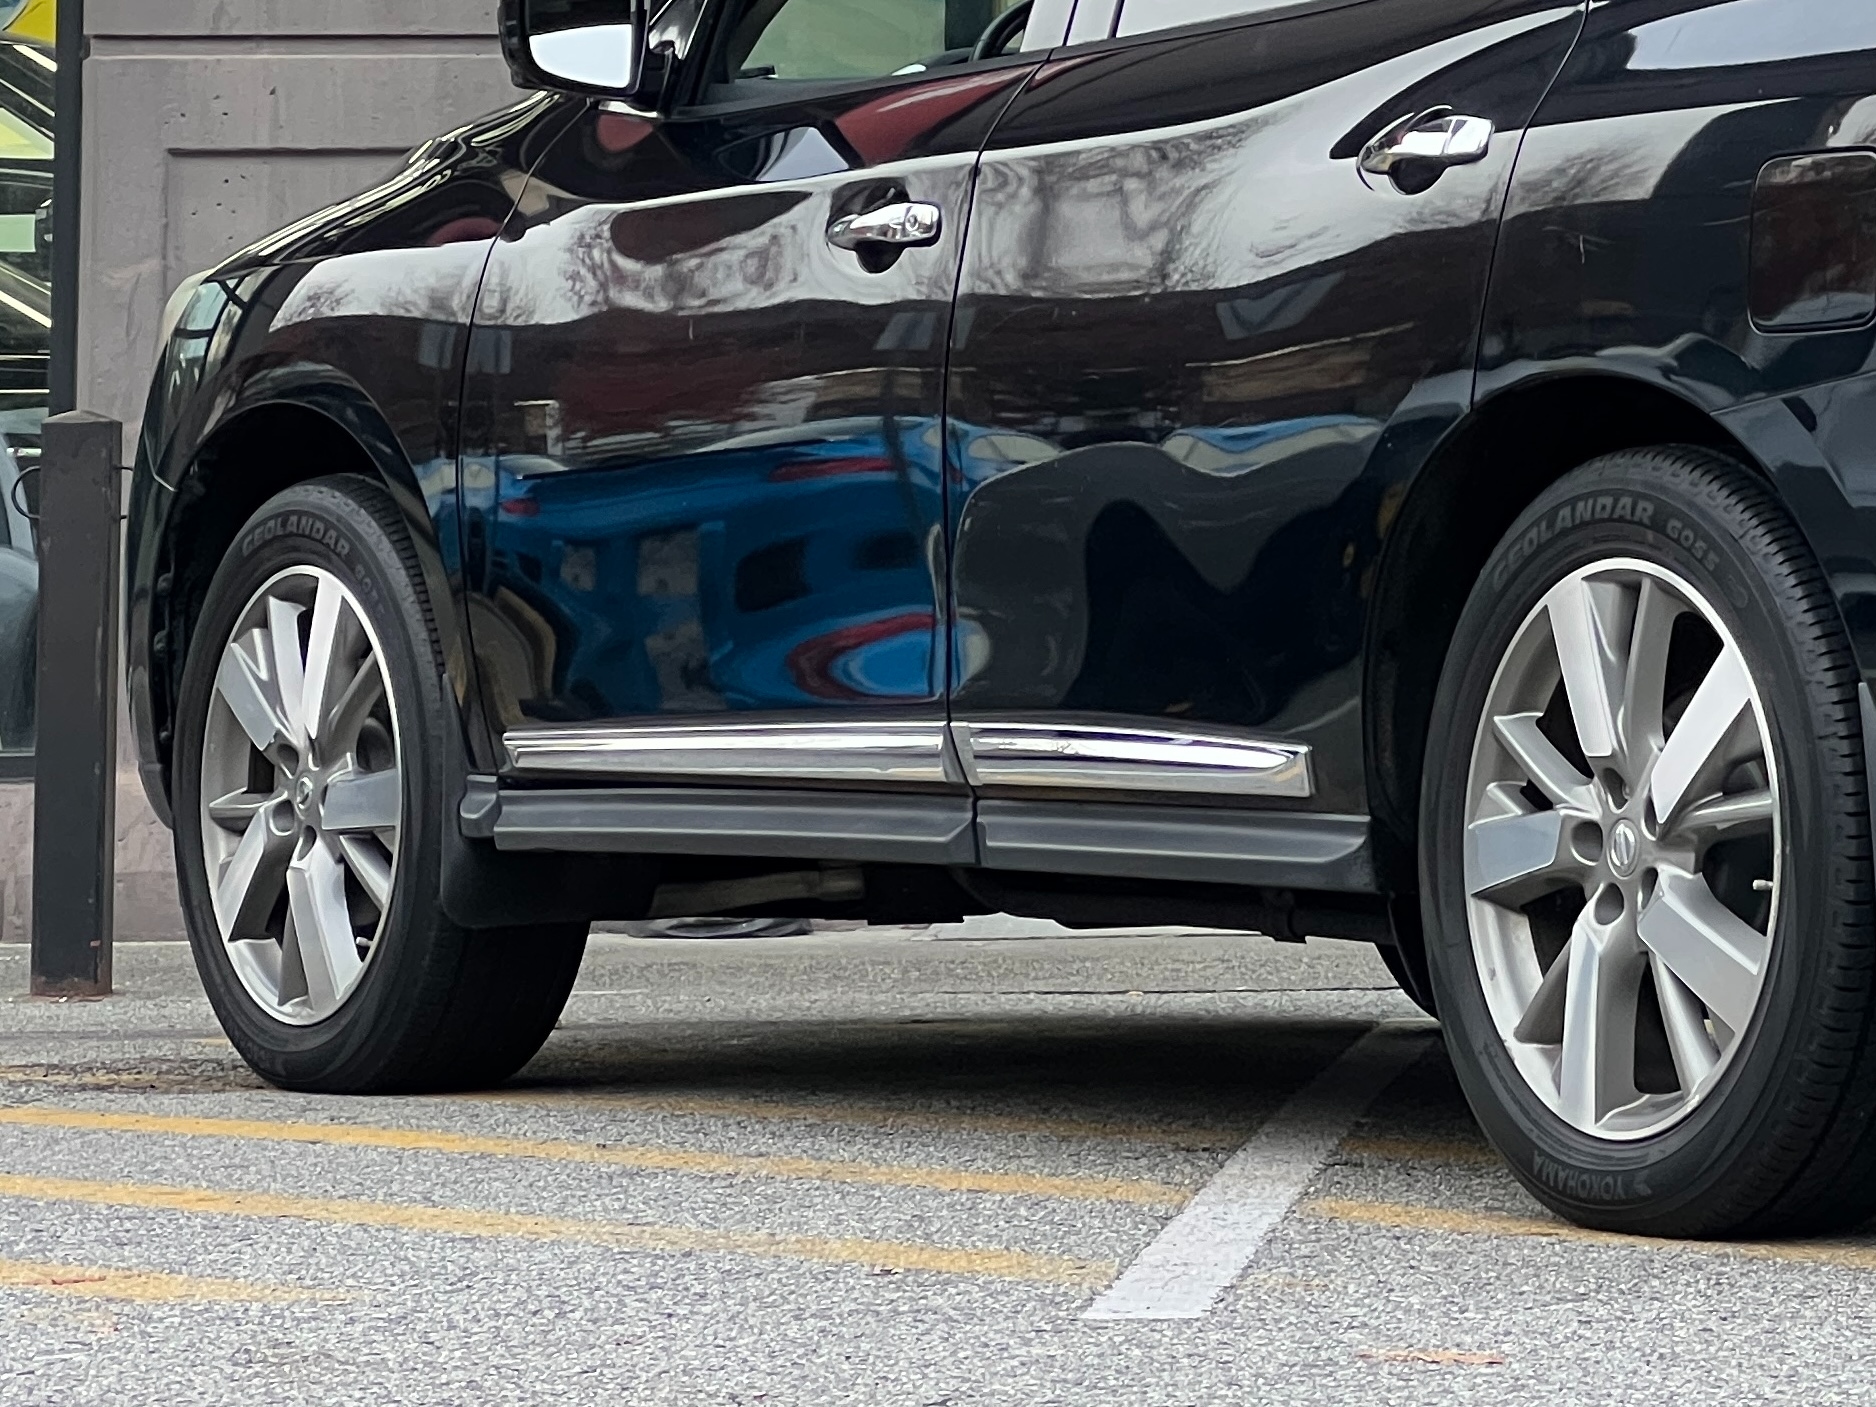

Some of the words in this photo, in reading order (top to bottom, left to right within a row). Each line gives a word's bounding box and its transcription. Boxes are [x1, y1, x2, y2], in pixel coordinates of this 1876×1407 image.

[241, 514, 351, 559] GEOLANDAR
[1492, 494, 1656, 592] GEOLANDAR
[1533, 1150, 1627, 1200] YOKOHAMA
